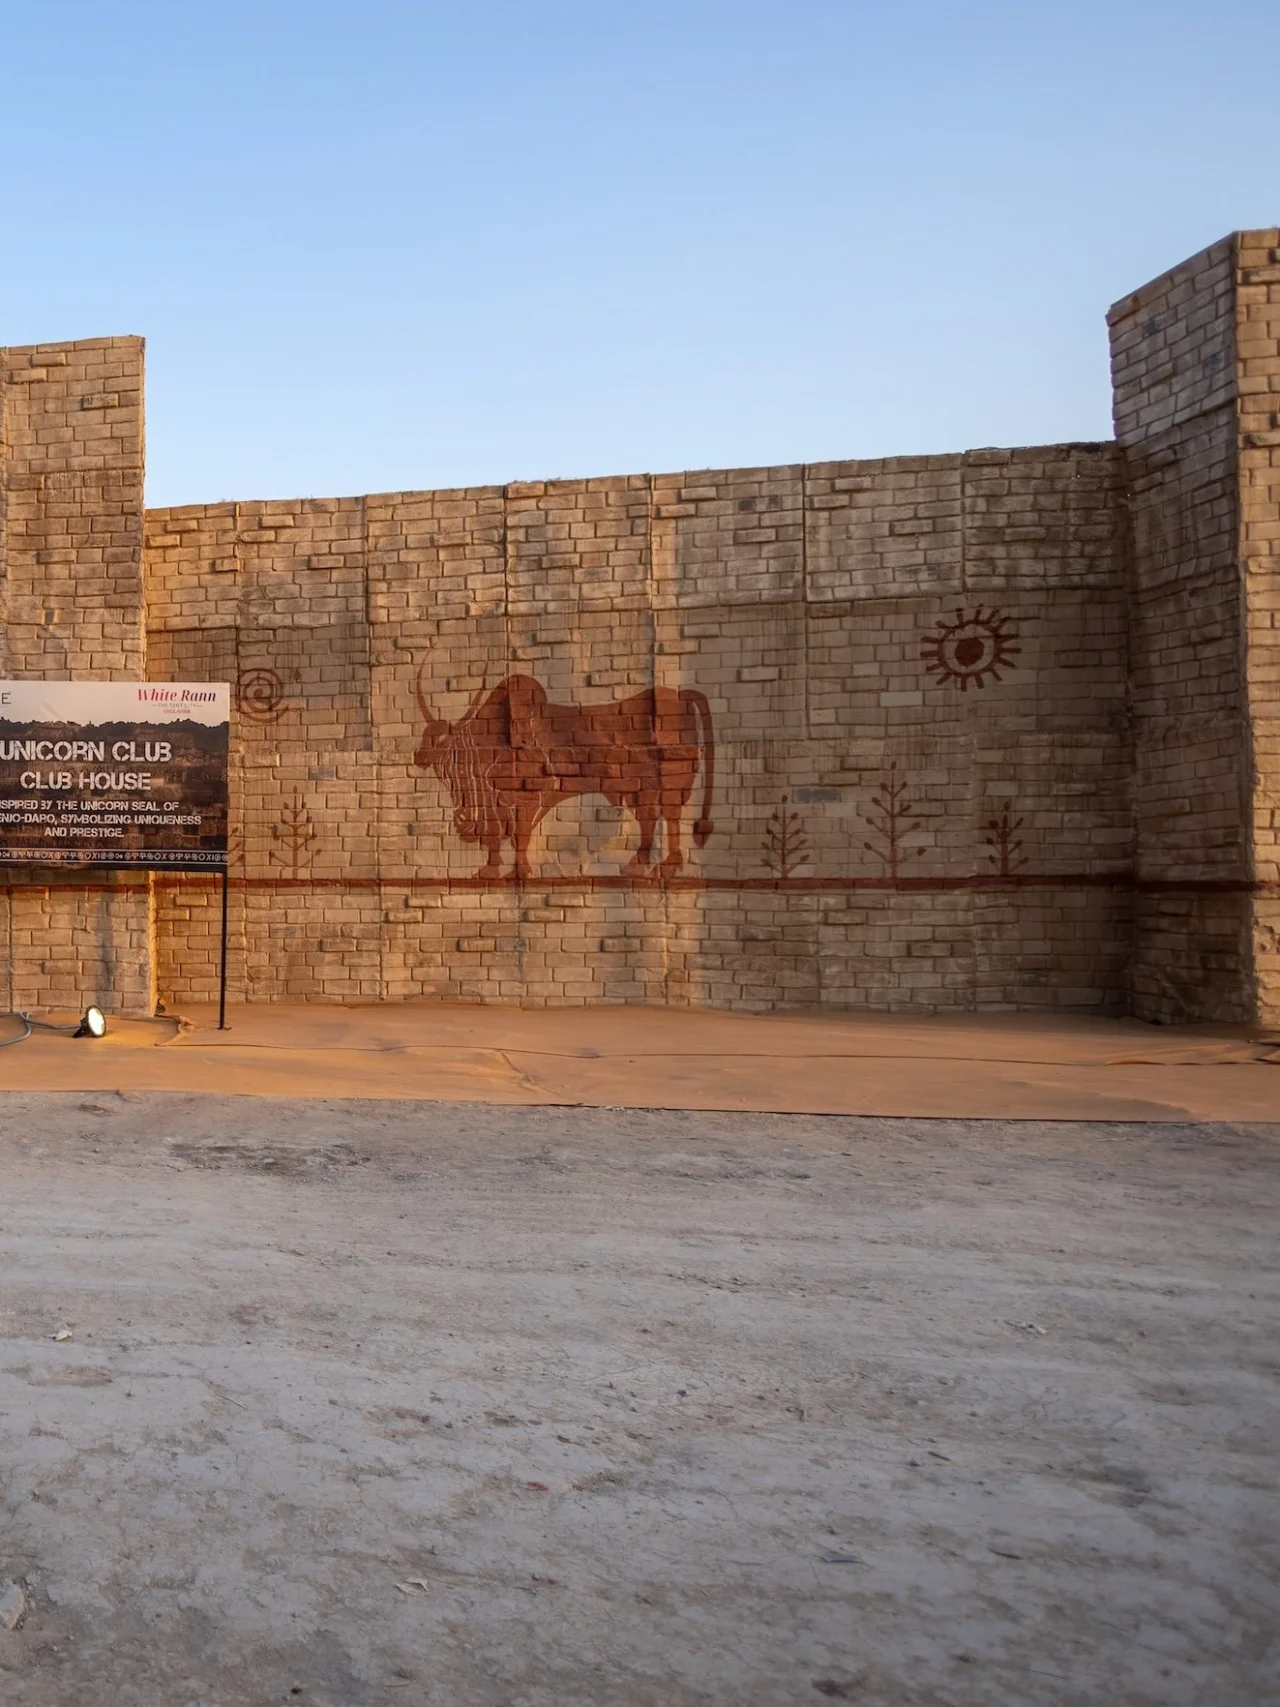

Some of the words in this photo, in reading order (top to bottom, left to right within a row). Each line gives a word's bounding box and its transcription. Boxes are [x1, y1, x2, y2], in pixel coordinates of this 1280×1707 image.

[137, 689, 177, 702] White
[181, 690, 216, 702] Rann
[0, 740, 105, 762] UNICORN
[111, 741, 172, 762] CLUB
[20, 771, 73, 790] CLUB
[78, 772, 151, 791] HOUSE
[40, 800, 53, 810] BY
[56, 800, 78, 811] THE
[80, 801, 129, 811] UNICORN
[131, 801, 160, 811] SEAL
[163, 801, 179, 811] OF
[60, 814, 131, 824] SYMBOLIZING
[134, 815, 201, 825] UNIQUENESS
[44, 826, 67, 837] AND
[69, 827, 124, 838] PRESTIGE.
